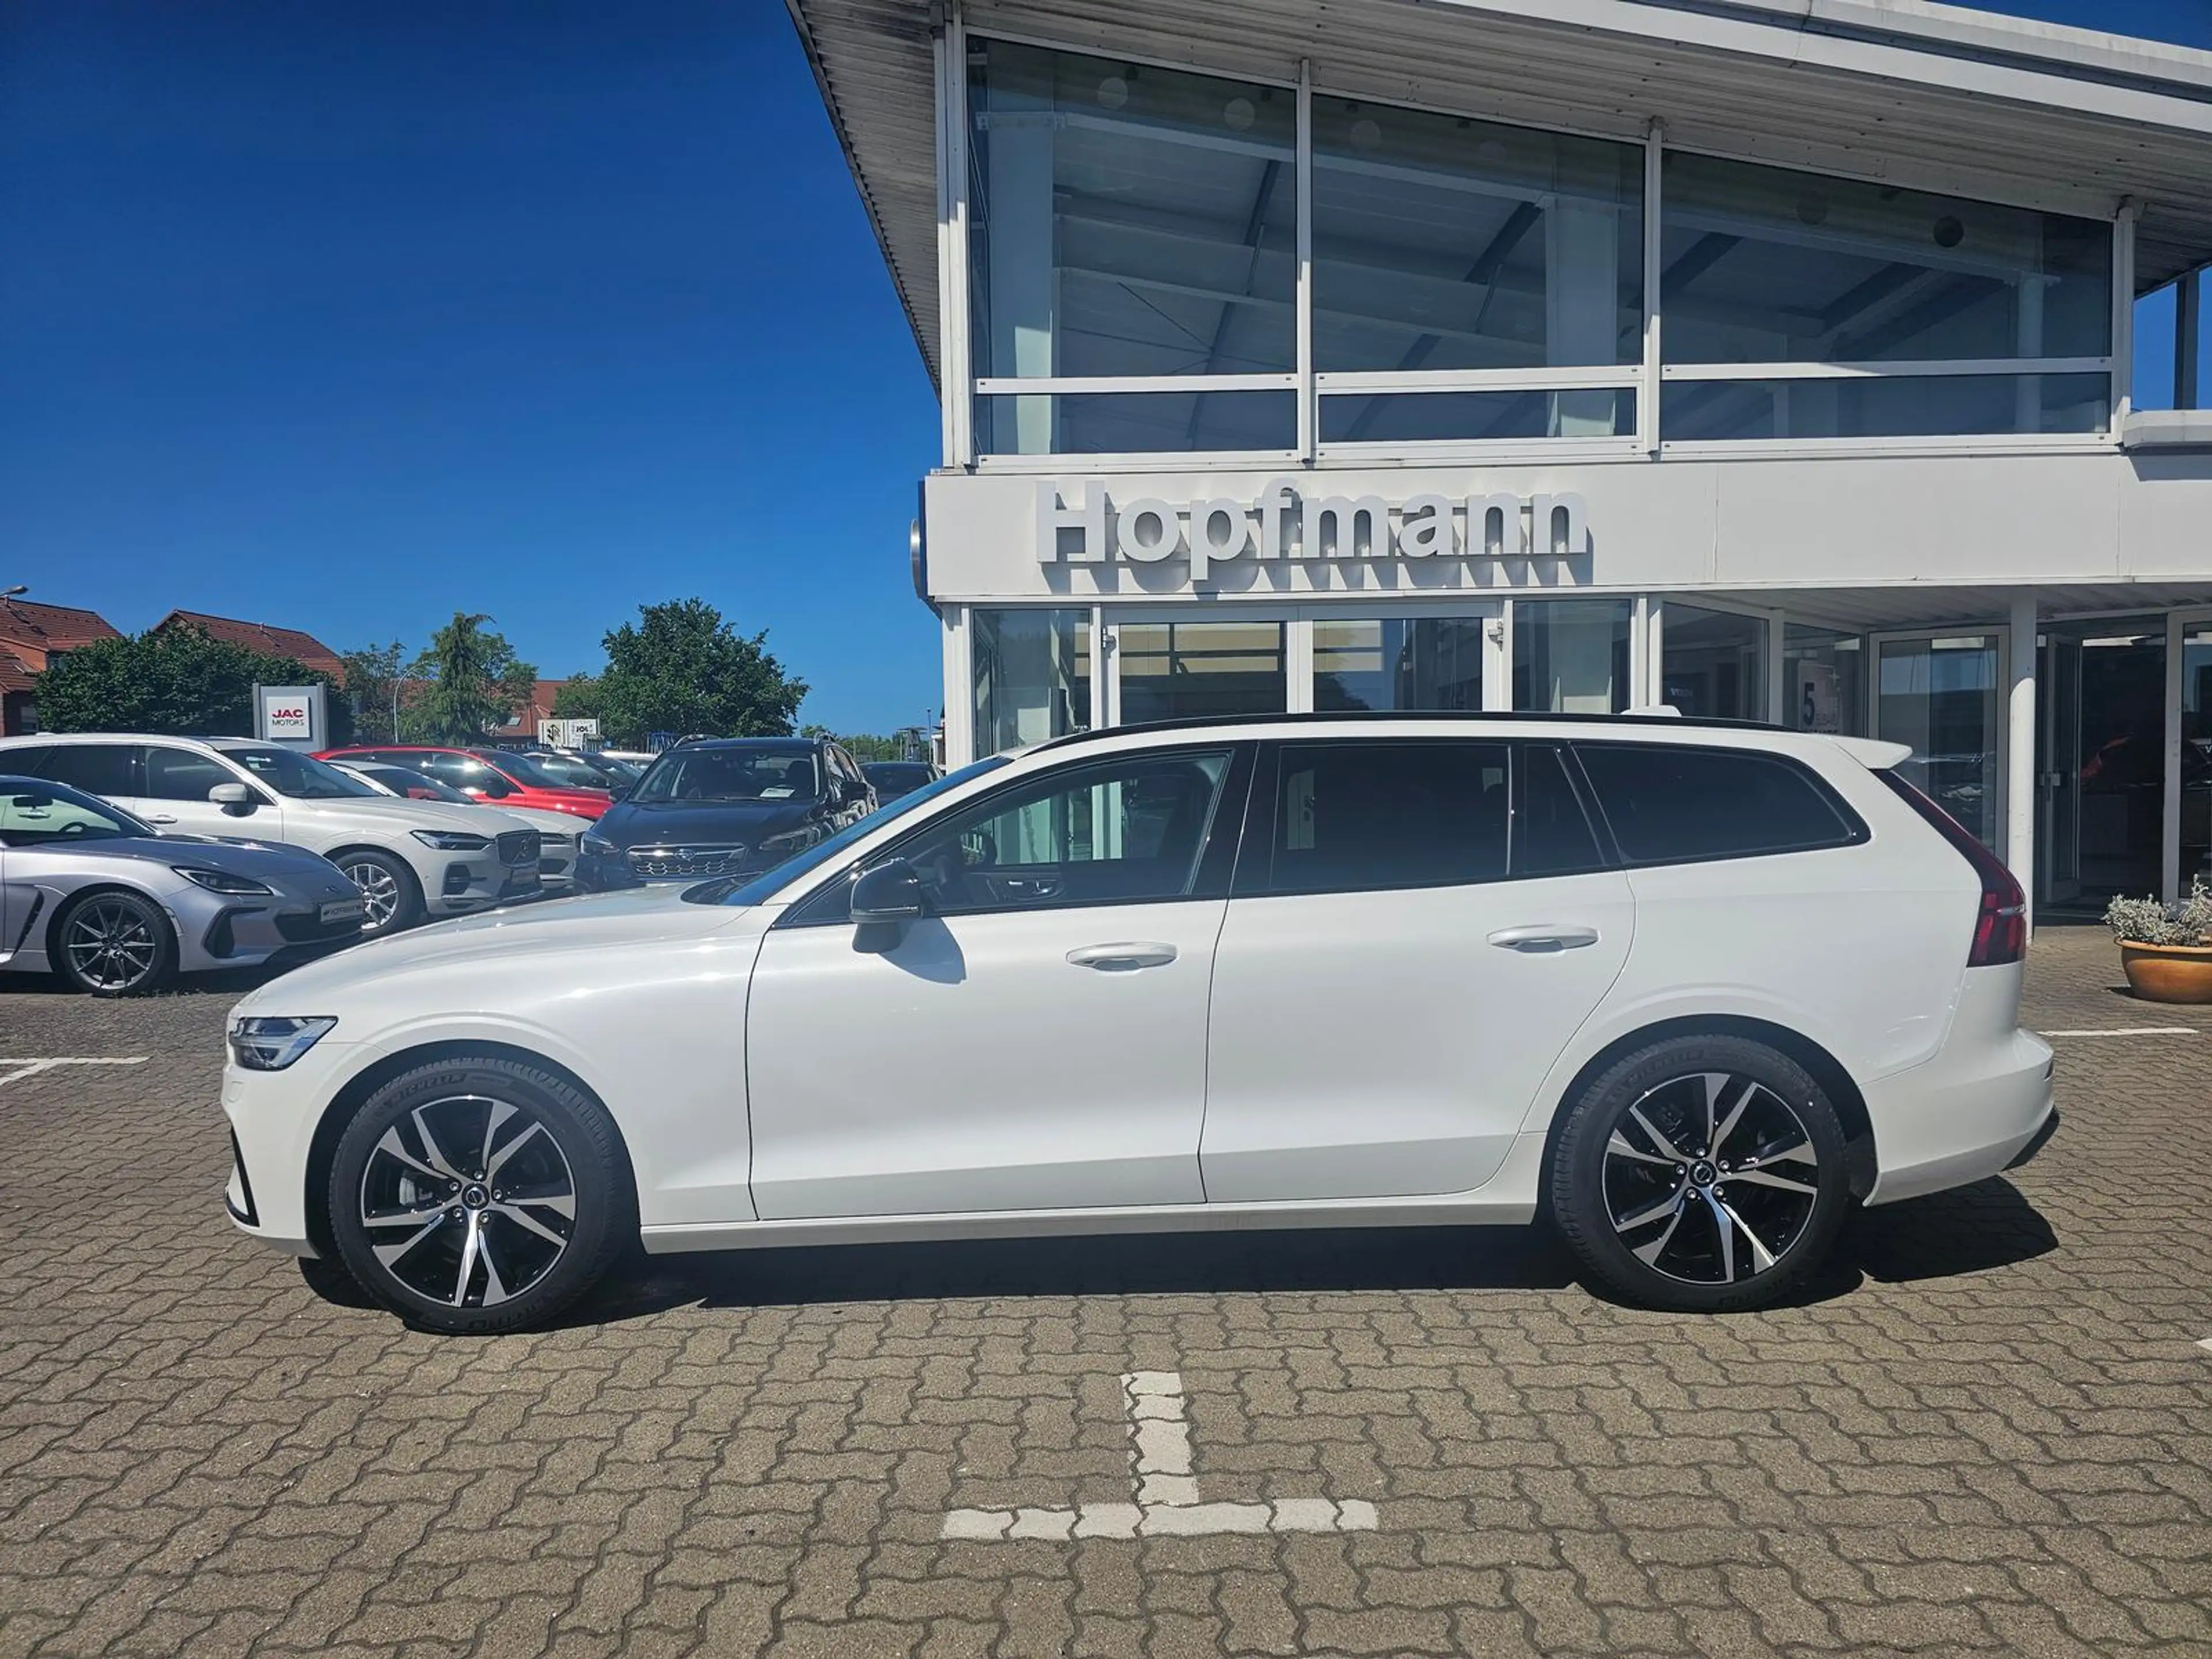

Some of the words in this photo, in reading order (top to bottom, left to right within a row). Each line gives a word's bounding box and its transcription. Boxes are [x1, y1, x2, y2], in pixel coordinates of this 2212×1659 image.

[1037, 478, 1588, 581] Hopfmann
[272, 709, 304, 718] JAC
[1803, 681, 1815, 726] 5
